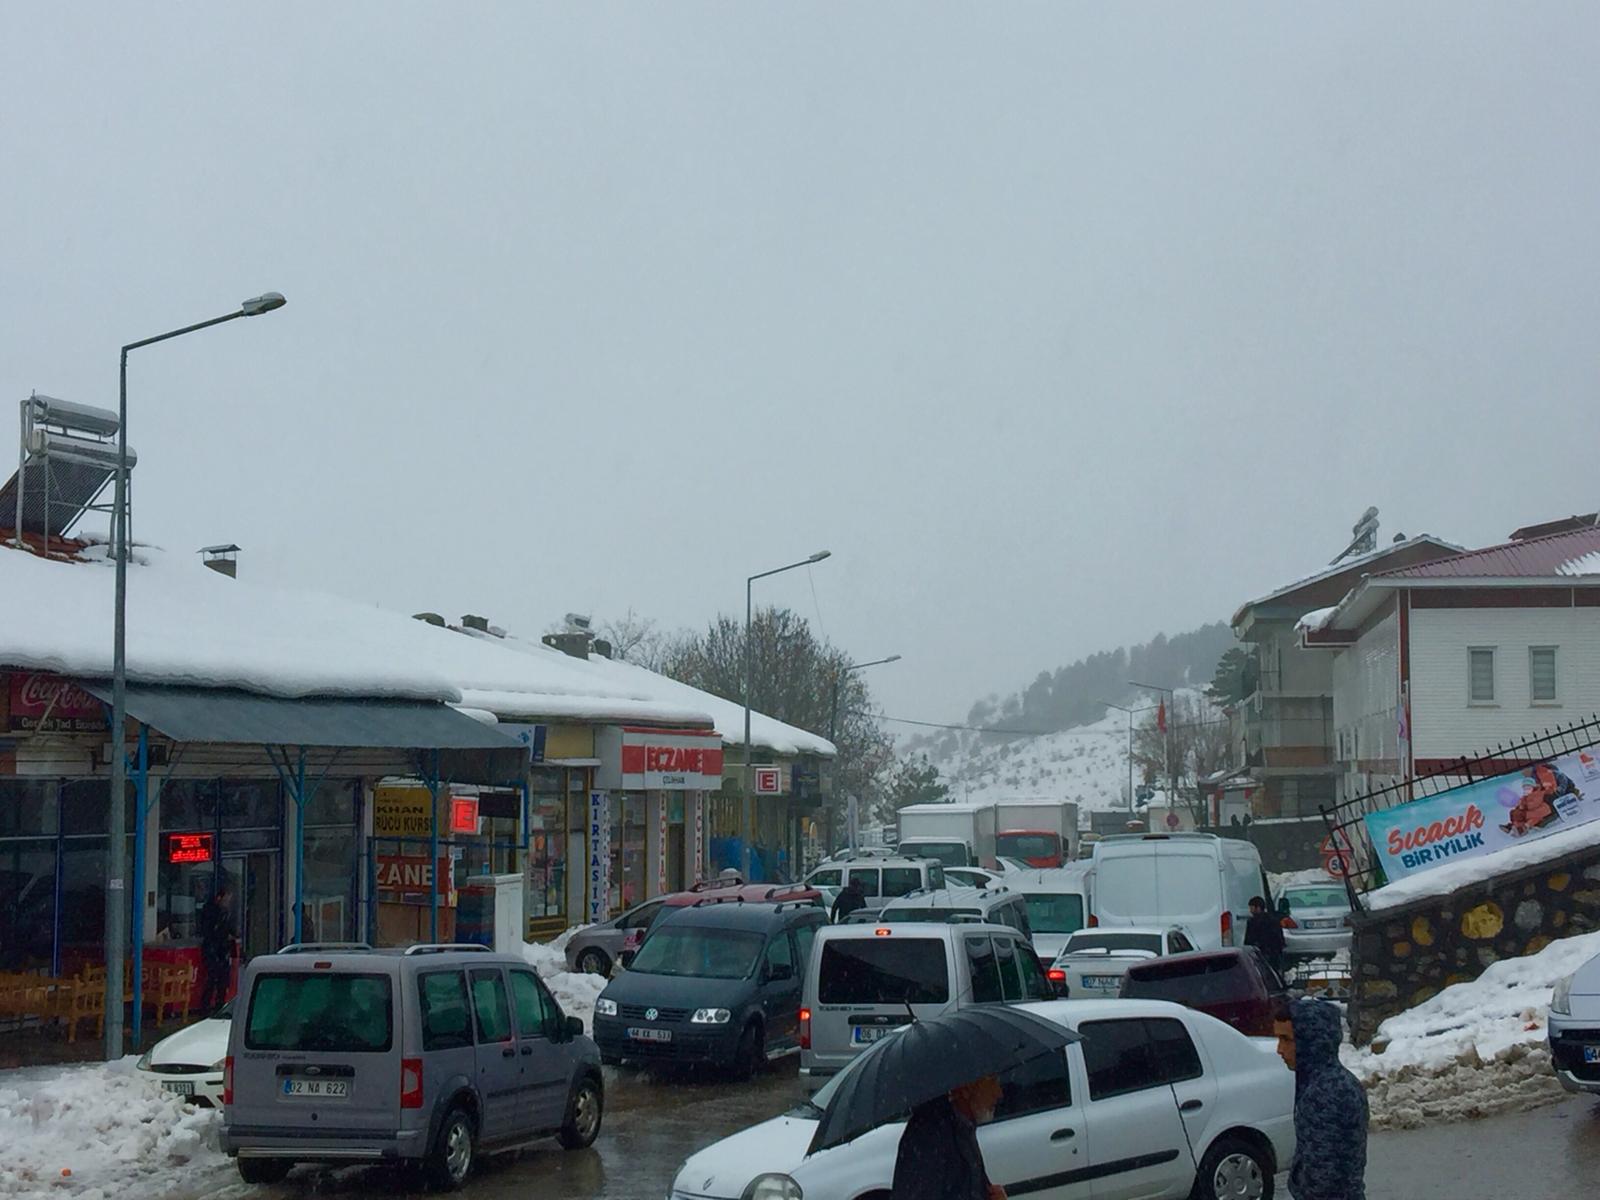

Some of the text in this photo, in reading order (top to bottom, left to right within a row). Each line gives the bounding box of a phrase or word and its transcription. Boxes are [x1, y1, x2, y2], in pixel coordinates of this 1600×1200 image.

[647, 747, 704, 772] ECZANE
[762, 774, 774, 789] E
[403, 816, 434, 832] KURS
[290, 1082, 345, 1094] 02 NA 622
